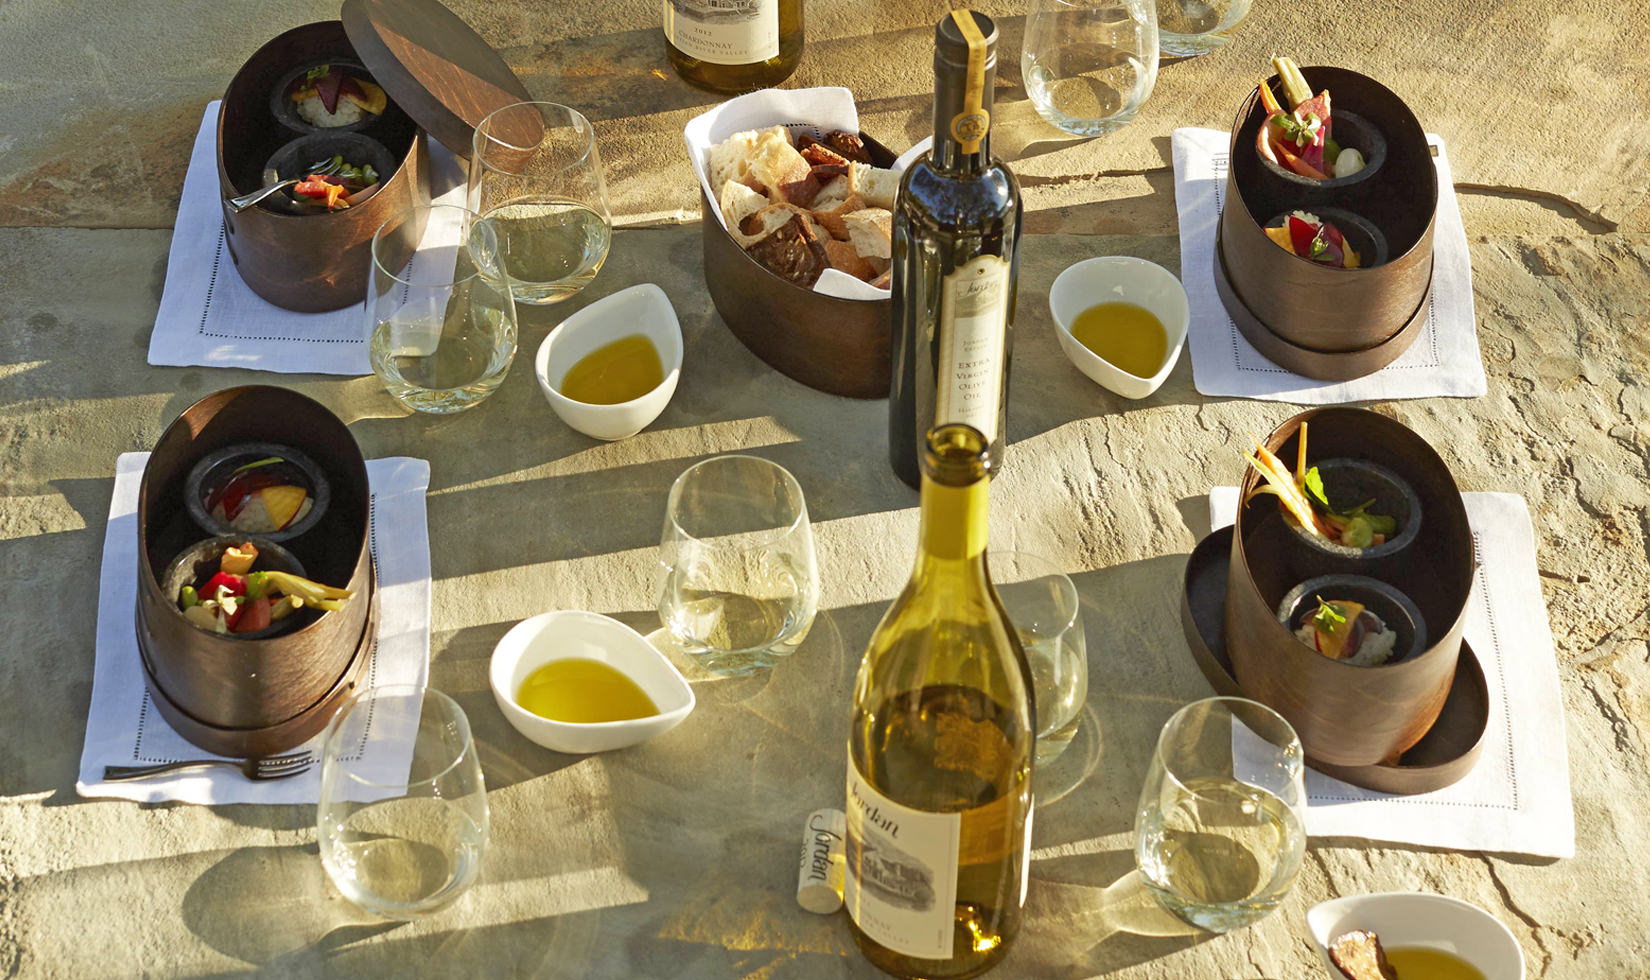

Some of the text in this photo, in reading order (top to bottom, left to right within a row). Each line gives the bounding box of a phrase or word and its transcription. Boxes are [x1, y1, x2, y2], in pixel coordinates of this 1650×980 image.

[958, 357, 990, 369] EXTRA
[957, 369, 989, 380] VIRGIN
[958, 381, 985, 391] OLIVE
[963, 393, 982, 401] OIL
[808, 814, 842, 881] Jordan
